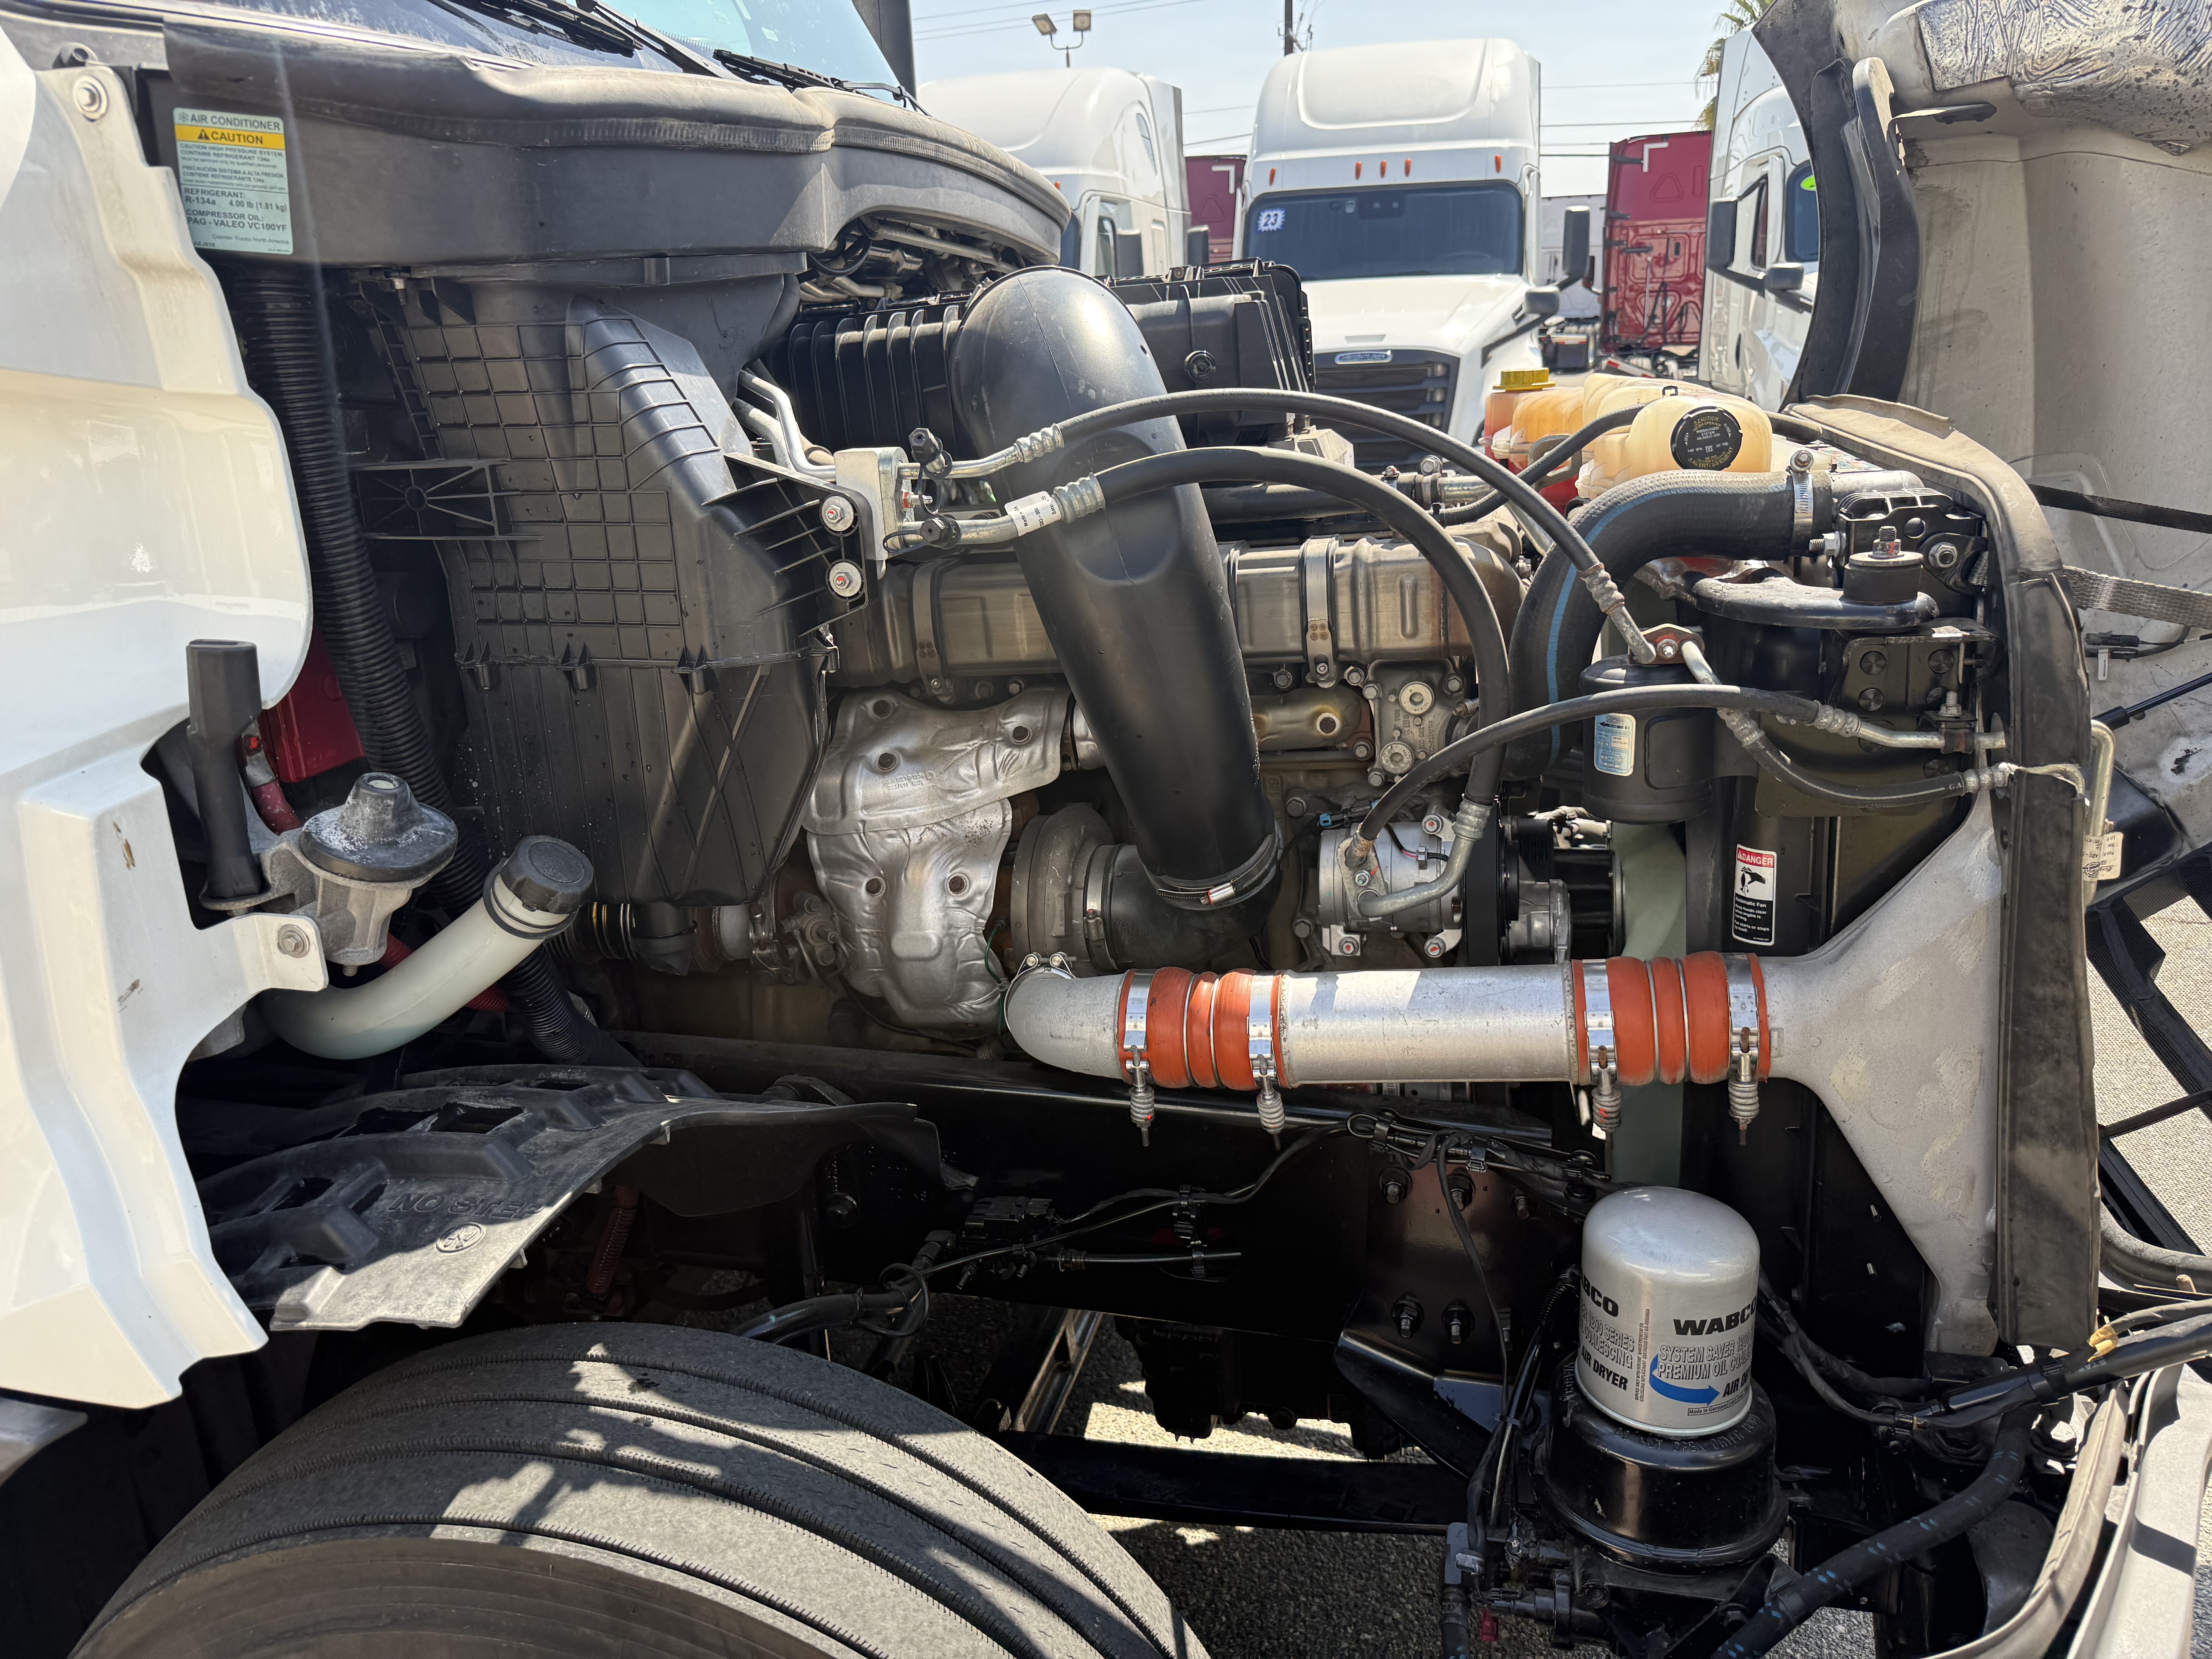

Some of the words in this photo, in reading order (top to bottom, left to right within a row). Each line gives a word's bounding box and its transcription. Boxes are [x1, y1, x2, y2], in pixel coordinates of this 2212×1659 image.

[190, 115, 208, 124] AIR
[211, 115, 280, 131] CONDITIONER
[211, 131, 264, 145] CAUTION
[213, 151, 256, 161] REFRIGERANT
[225, 146, 258, 155] PRESSURE
[184, 187, 246, 200] REFRIGERANT:
[185, 196, 216, 206] R-134a
[229, 199, 244, 208] 4.00
[246, 200, 254, 209] lb
[256, 202, 273, 211] (1.81
[275, 203, 288, 213] kg)
[186, 209, 246, 221] COMPRESSOR
[248, 214, 264, 222] OIL:
[1264, 213, 1278, 227] 23
[187, 217, 207, 226] PAG
[213, 219, 245, 229] VALEO
[249, 222, 287, 232] VC100YF
[1697, 416, 1719, 424] CAUTION
[1691, 447, 1734, 468] AVERTISSEMENT
[1742, 854, 1774, 866] DANGER
[1735, 896, 1756, 907] Automatic
[1743, 911, 1756, 919] engine
[388, 1193, 446, 1212] NO
[448, 1195, 545, 1221] STEP
[1581, 1273, 1619, 1317] BCO
[1588, 1315, 1604, 1334] 1200
[1604, 1323, 1635, 1353] SERIES
[1585, 1326, 1633, 1370] COALESCING
[1659, 1344, 1704, 1363] SYSTEM
[1706, 1340, 1735, 1361] SAVER
[1581, 1344, 1592, 1367] AIR
[1592, 1358, 1628, 1391] DRYER
[1657, 1361, 1711, 1380] PREMIUM
[1712, 1359, 1728, 1377] OIL
[1722, 1377, 1740, 1398] AIR
[1740, 1370, 1750, 1389] DR
[1709, 1403, 1728, 1412] Germany
[1613, 1427, 1630, 1441] DO
[1638, 1436, 1664, 1450] NOT
[1672, 1441, 1707, 1453] OPEN
[1710, 1430, 1745, 1450] DRYER
